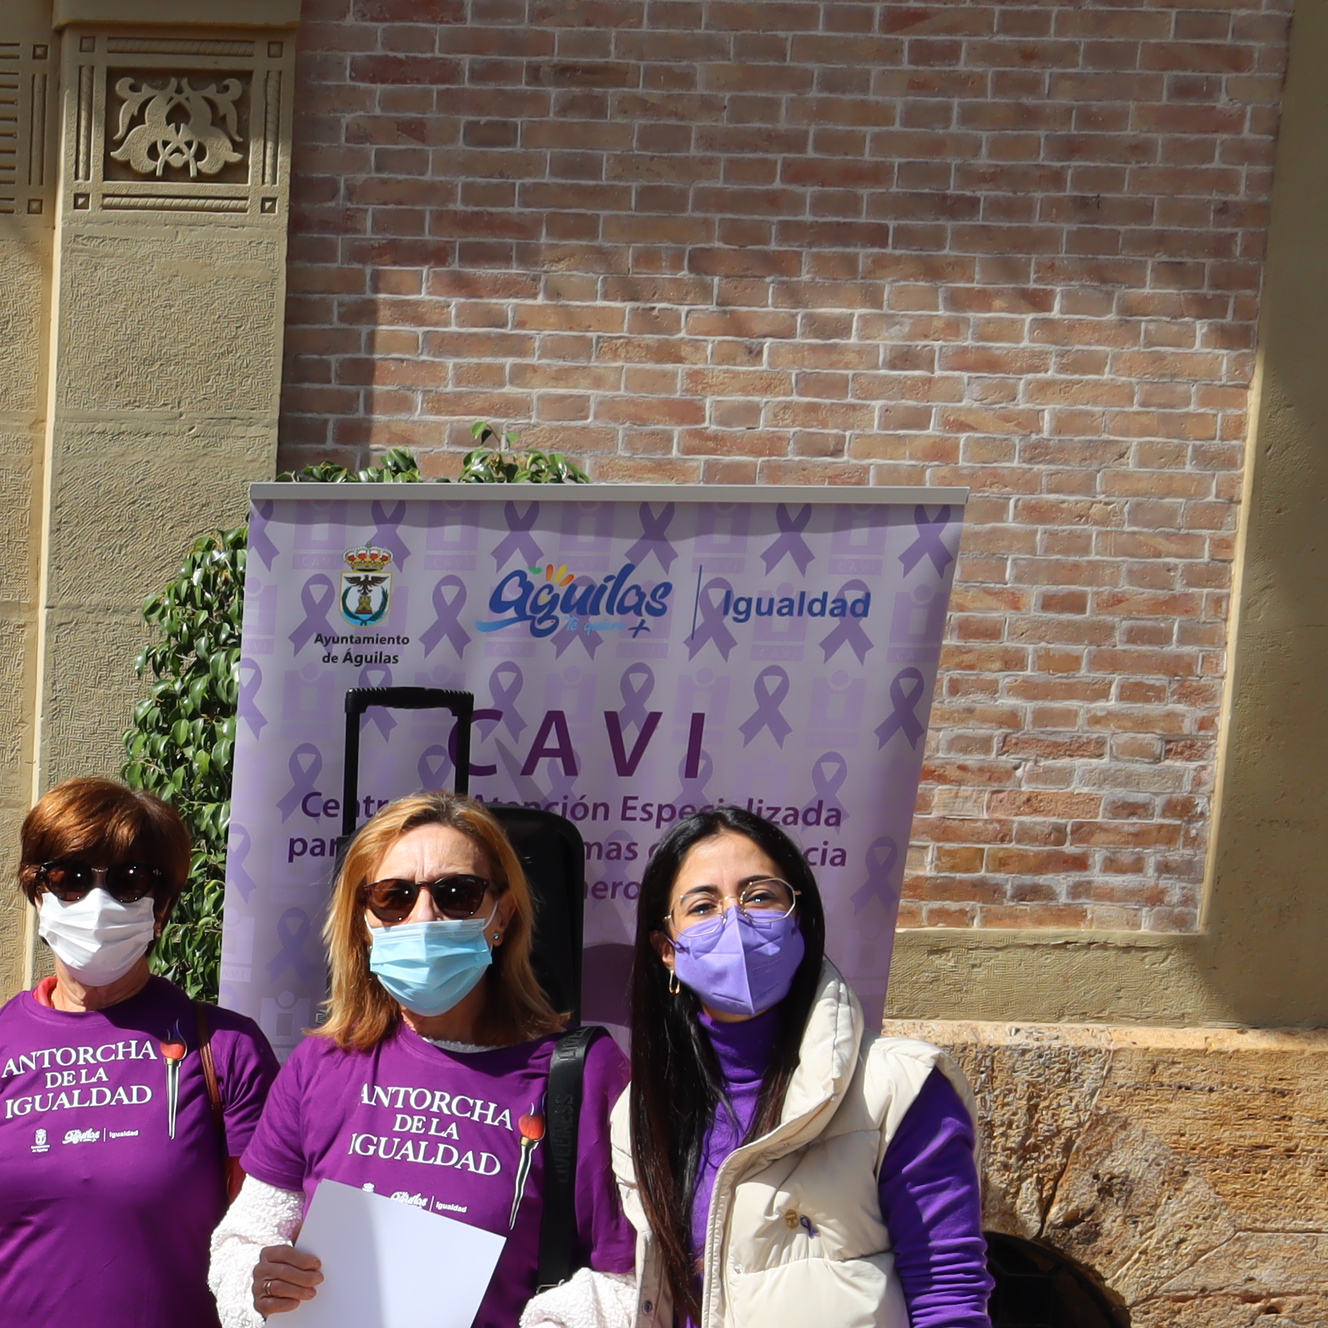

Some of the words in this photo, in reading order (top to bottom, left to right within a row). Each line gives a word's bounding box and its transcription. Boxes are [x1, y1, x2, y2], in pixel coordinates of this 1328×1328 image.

[722, 590, 871, 623] Igualdad
[313, 633, 410, 647] Ayuntamiento
[322, 652, 339, 664] de
[342, 648, 400, 667] Águilas
[448, 709, 705, 778] CAVI
[288, 836, 340, 862] par
[1, 1039, 157, 1079] ANTORCHA
[45, 1069, 76, 1089] DE
[80, 1067, 109, 1083] LA
[4, 1084, 153, 1119] IGUALDAD
[360, 1083, 514, 1132] ANTORCHA
[393, 1114, 426, 1135] DE
[428, 1116, 460, 1140] LA
[348, 1133, 501, 1176] IGUALDAD
[436, 1202, 467, 1213] Igualdad
